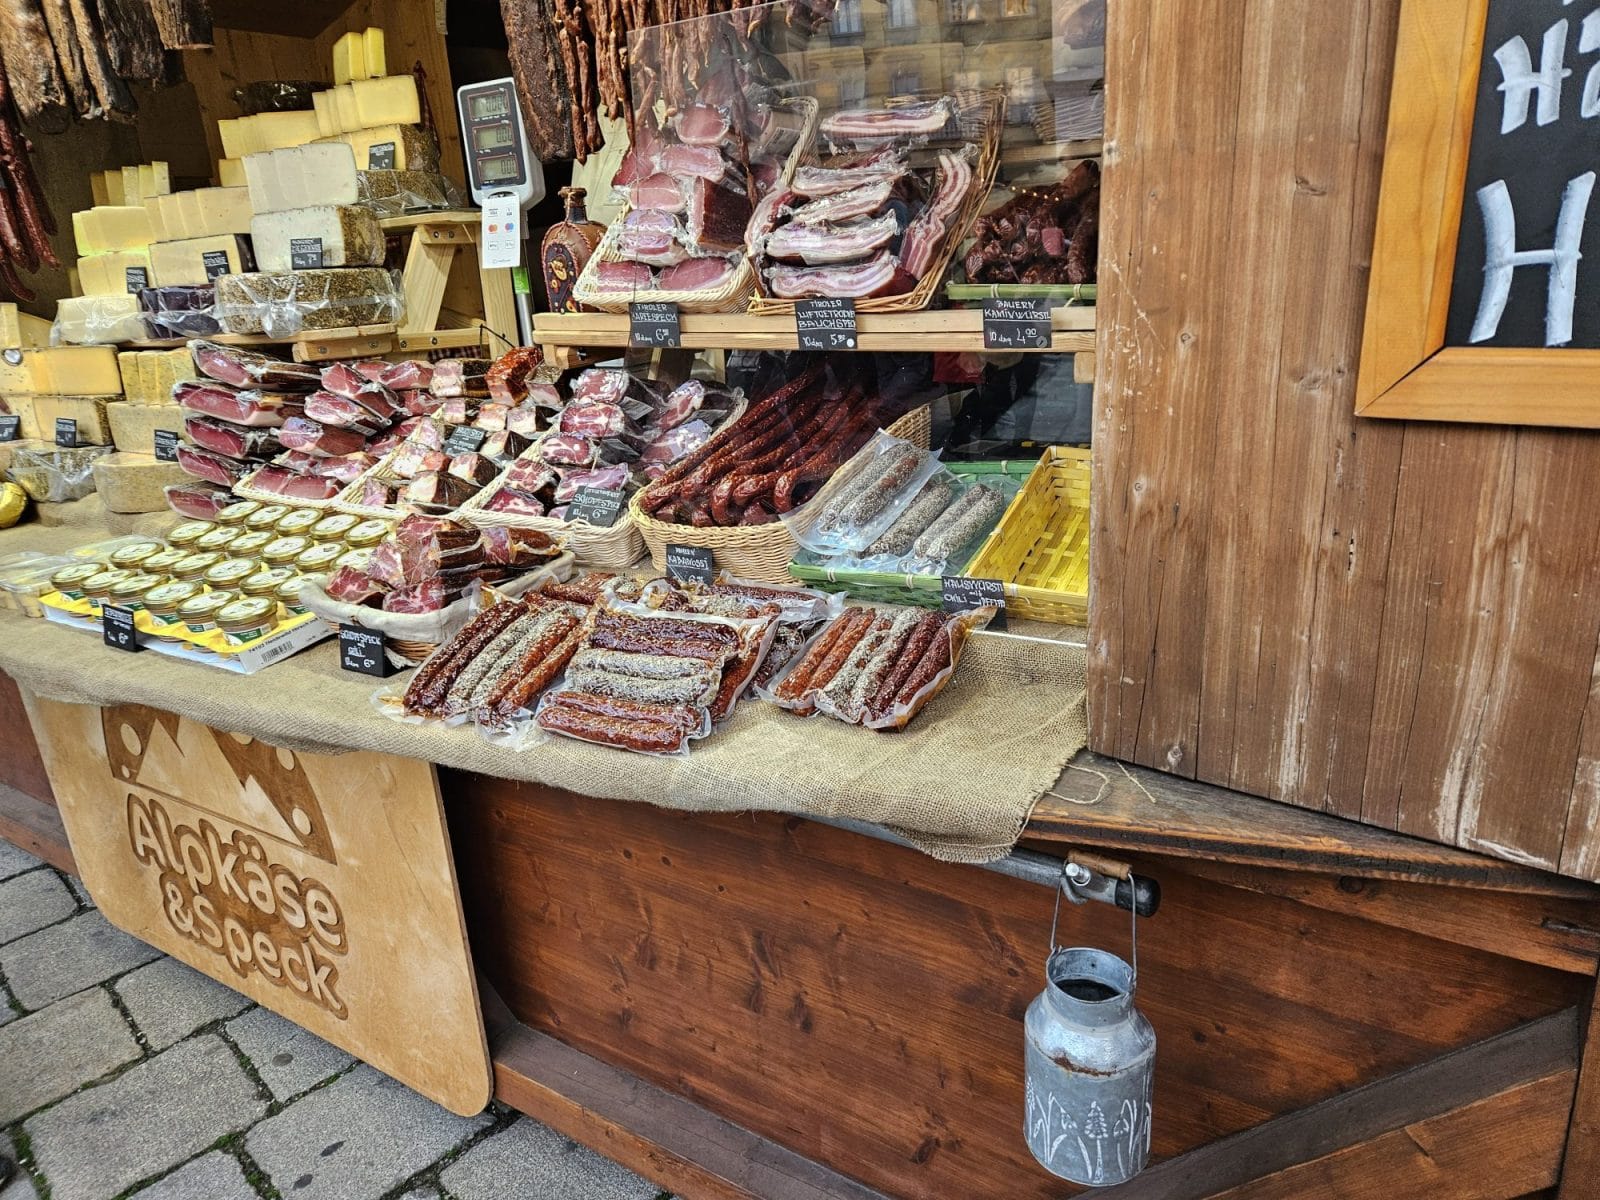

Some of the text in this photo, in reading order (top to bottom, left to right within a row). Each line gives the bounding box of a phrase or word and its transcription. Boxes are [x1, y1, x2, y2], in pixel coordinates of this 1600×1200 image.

[810, 299, 842, 308] TIROLER
[996, 300, 1036, 309] BAUERN
[129, 797, 347, 950] Alpkäse
